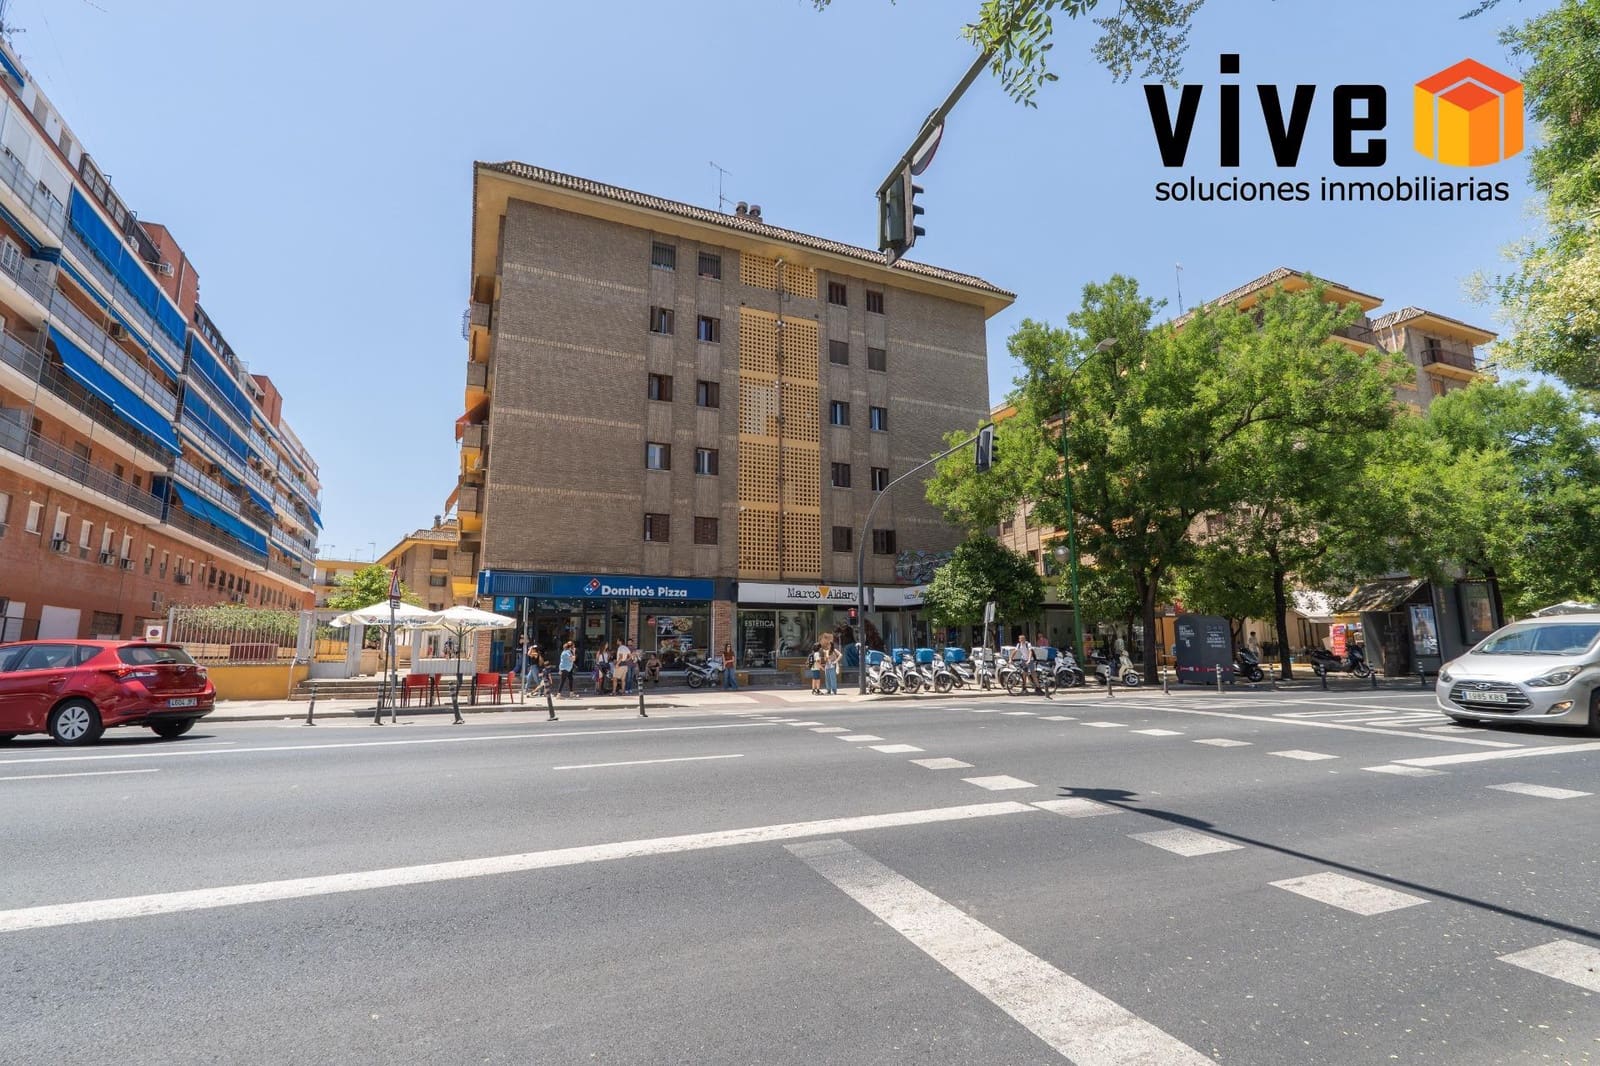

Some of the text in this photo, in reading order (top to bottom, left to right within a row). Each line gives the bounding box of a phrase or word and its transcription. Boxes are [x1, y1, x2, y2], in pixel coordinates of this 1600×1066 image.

[601, 585, 688, 598] Domino's Pizza
[786, 587, 858, 602] Marco Aldany
